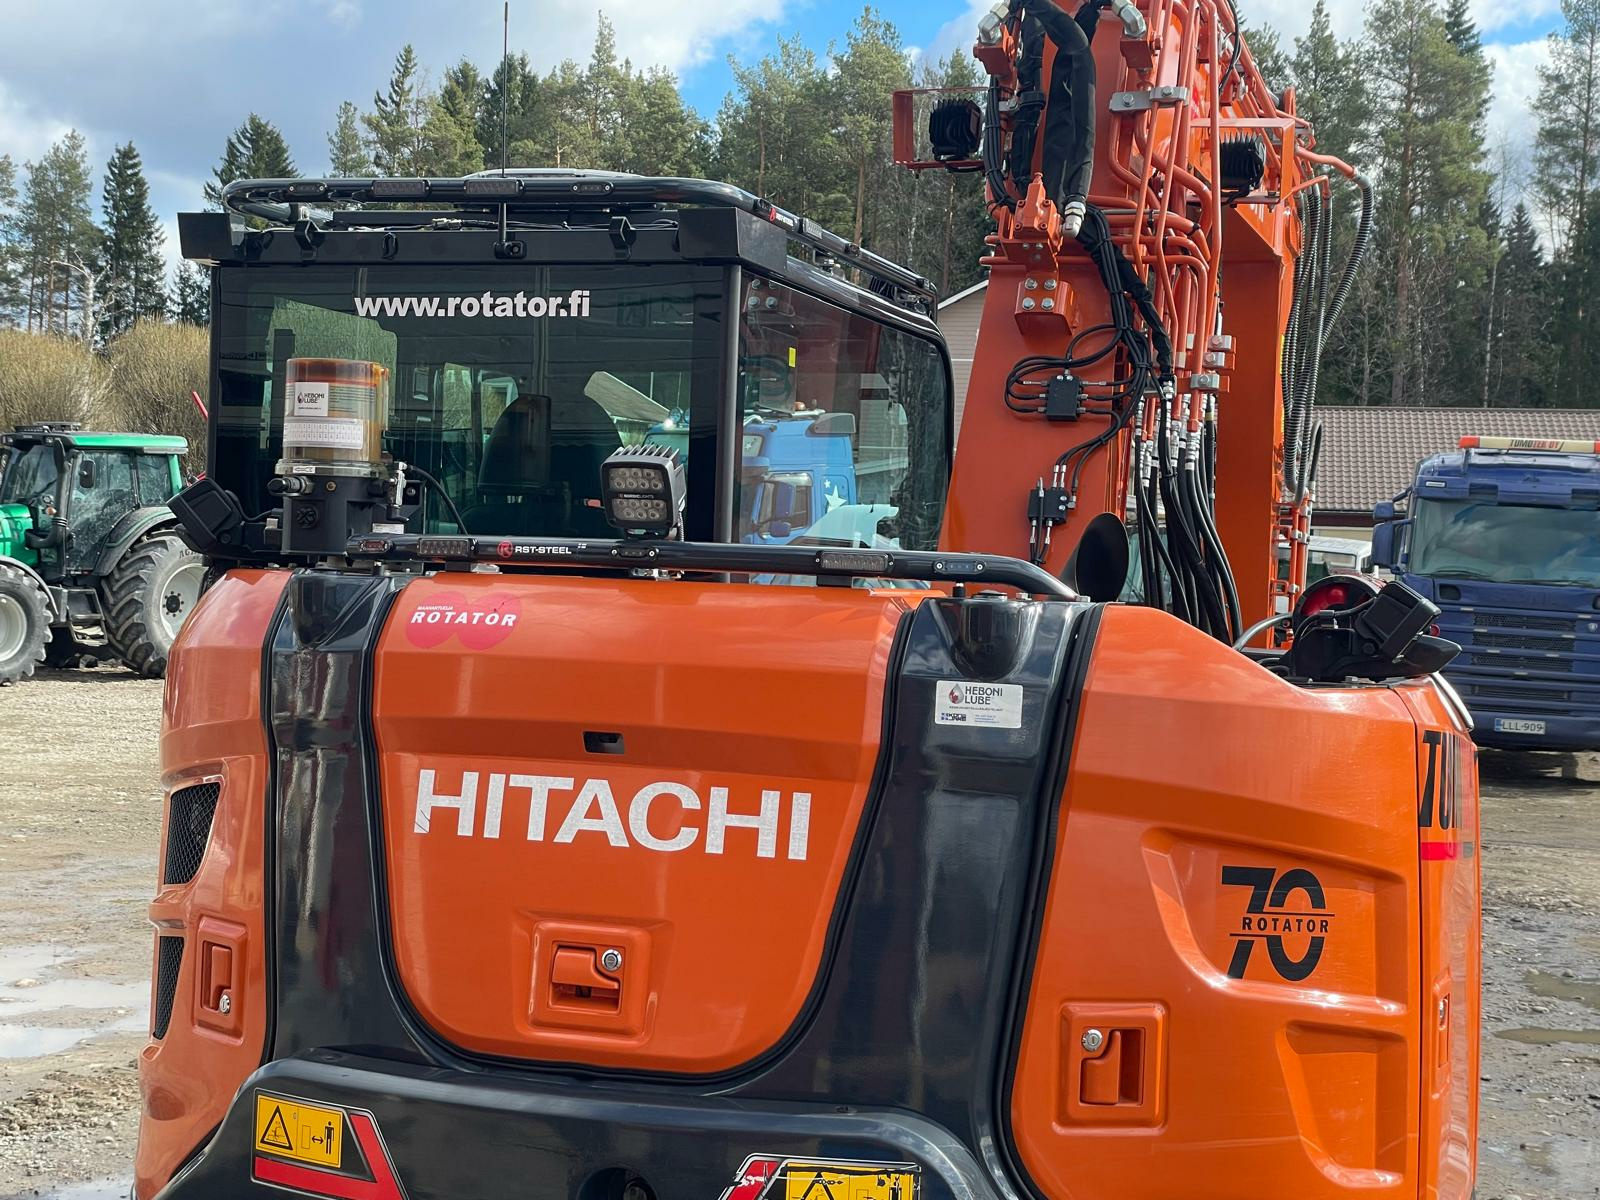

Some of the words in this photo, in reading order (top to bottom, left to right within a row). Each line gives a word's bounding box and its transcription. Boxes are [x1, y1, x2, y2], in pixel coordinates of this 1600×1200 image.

[354, 290, 590, 317] www.rotator.fi
[515, 546, 572, 554] RST-STEEL
[411, 611, 516, 627] ROTATOR
[965, 686, 1003, 697] HEBONI
[964, 696, 991, 705] LUBE
[1502, 721, 1545, 732] LLL-909
[413, 769, 811, 860] HITACHI
[1221, 865, 1326, 981] 70
[1242, 917, 1329, 933] ROTATOR
